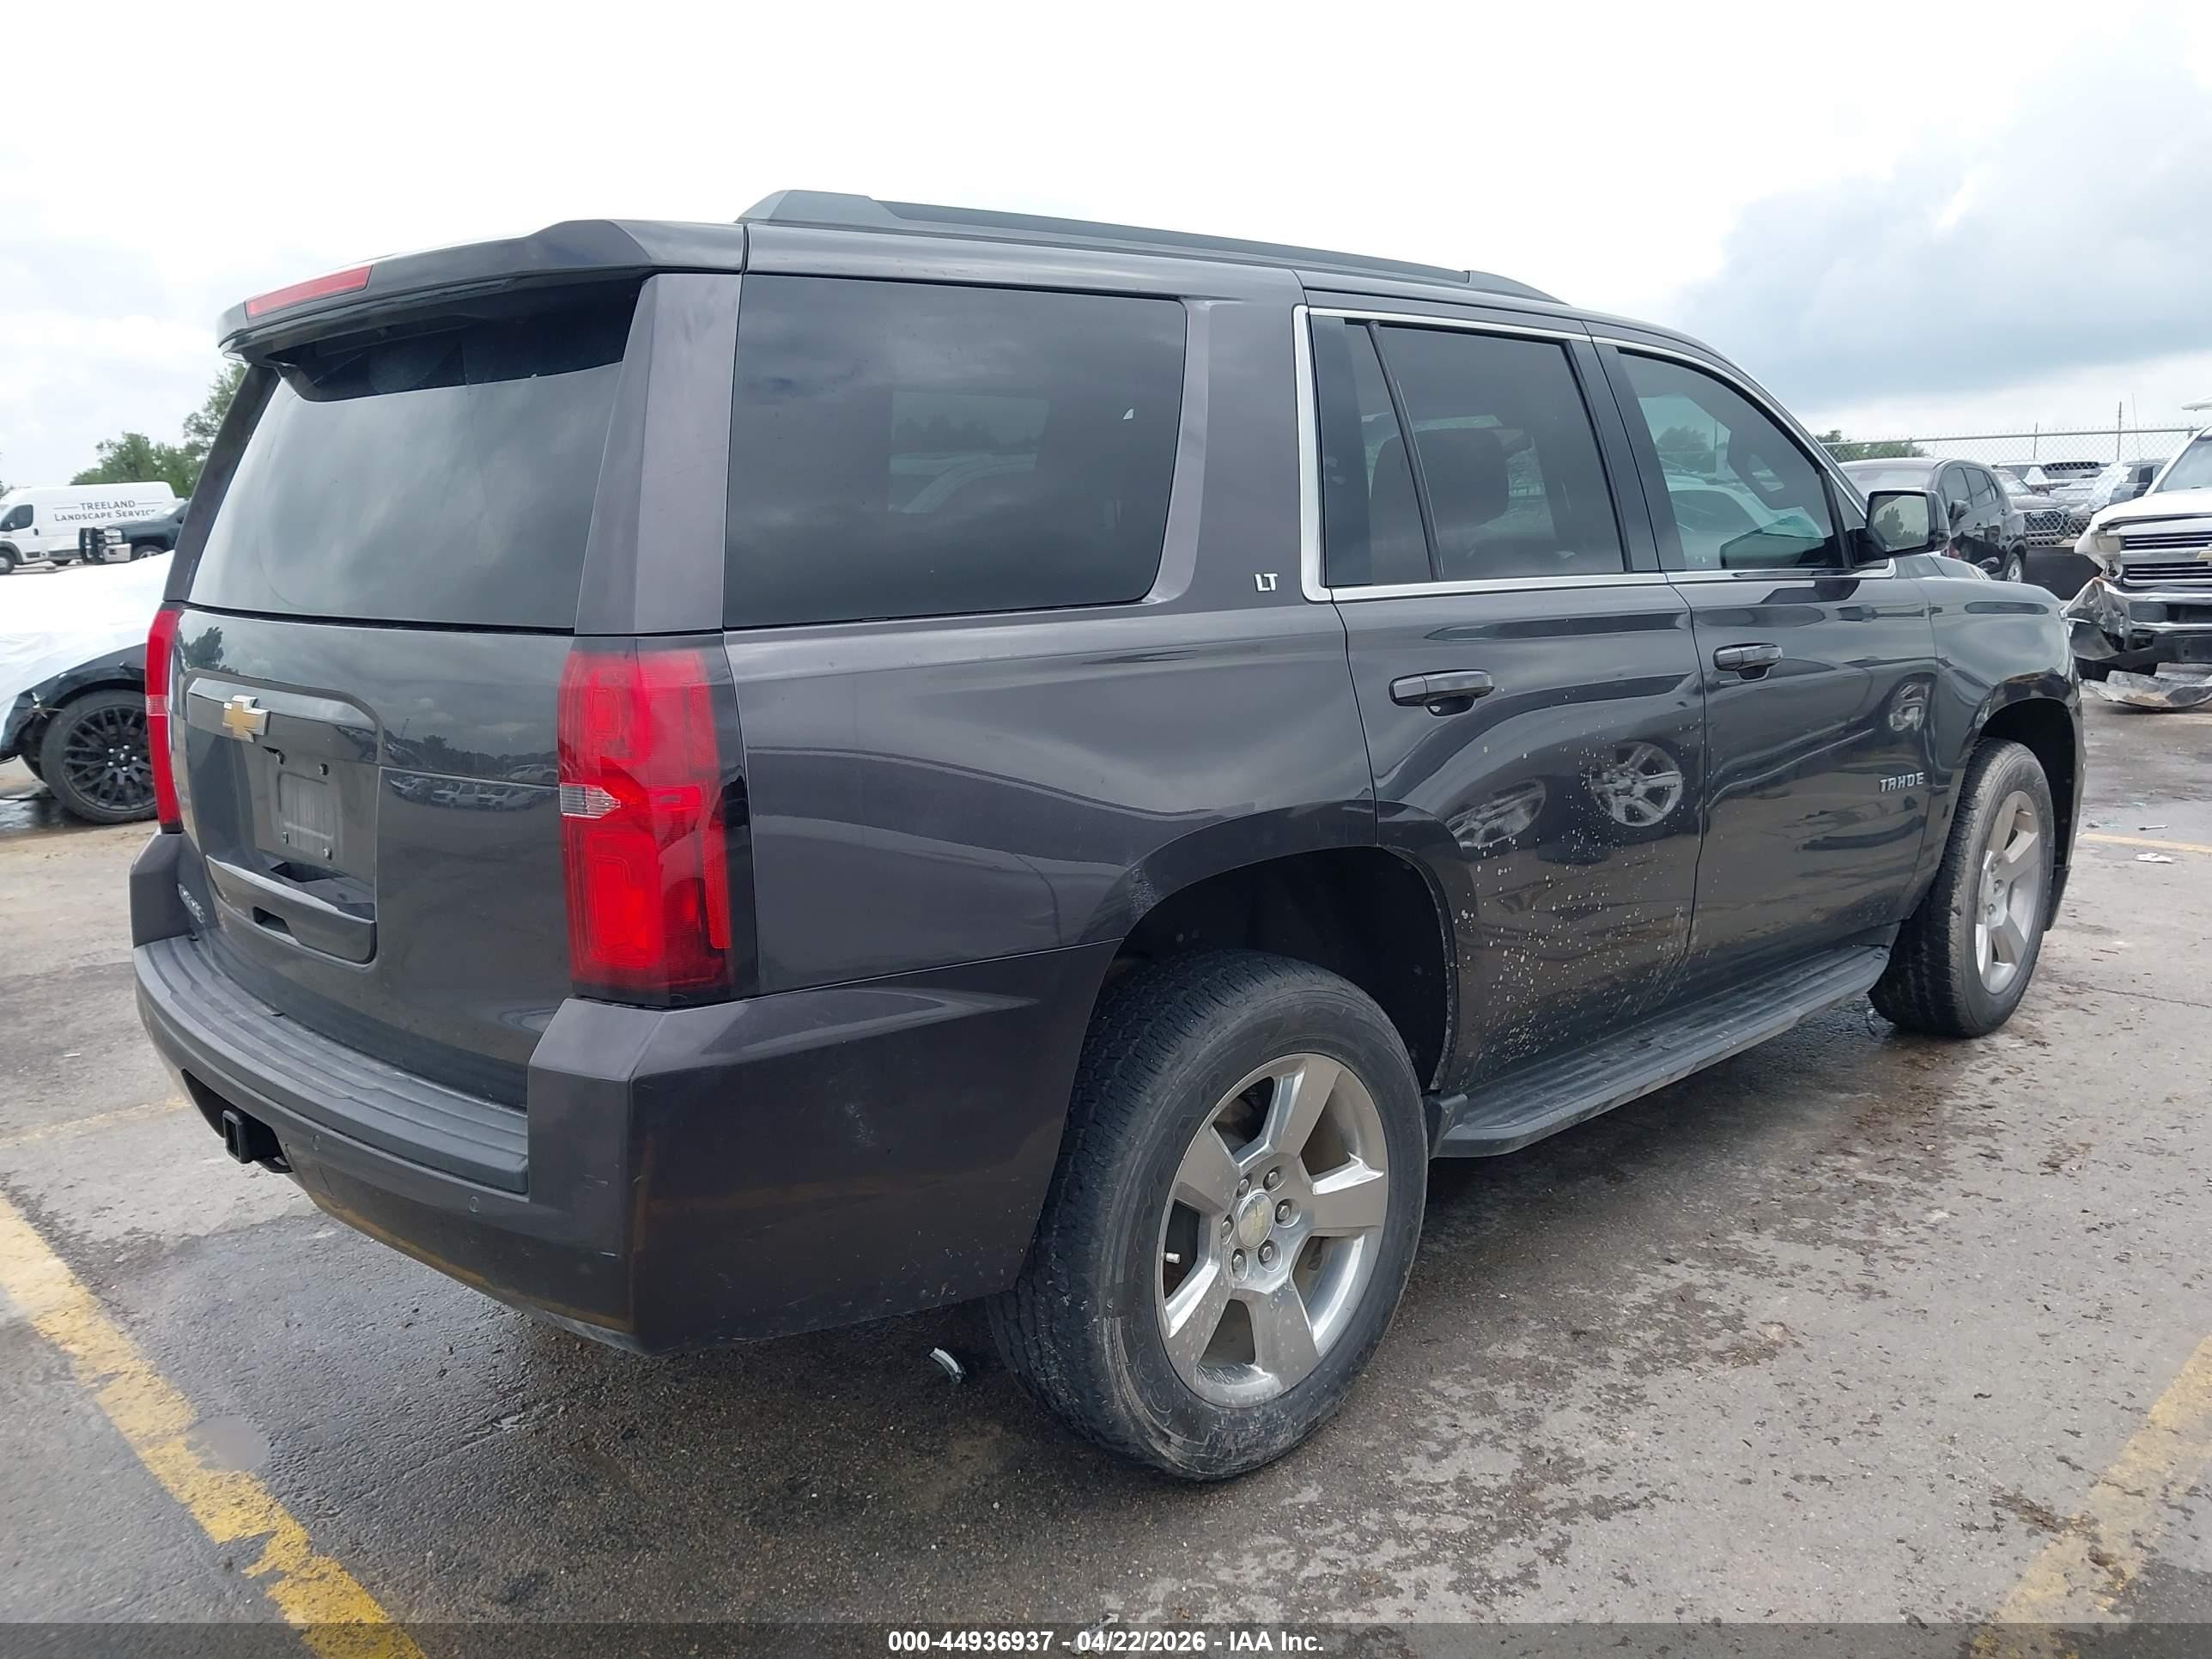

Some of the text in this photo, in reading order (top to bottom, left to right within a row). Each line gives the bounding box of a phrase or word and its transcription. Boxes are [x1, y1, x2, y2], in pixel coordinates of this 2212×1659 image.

[80, 500, 136, 511] TREELAND
[54, 511, 112, 521] LANDSCAPE
[1255, 572, 1279, 592] LT
[1880, 771, 1924, 792] TAHOE
